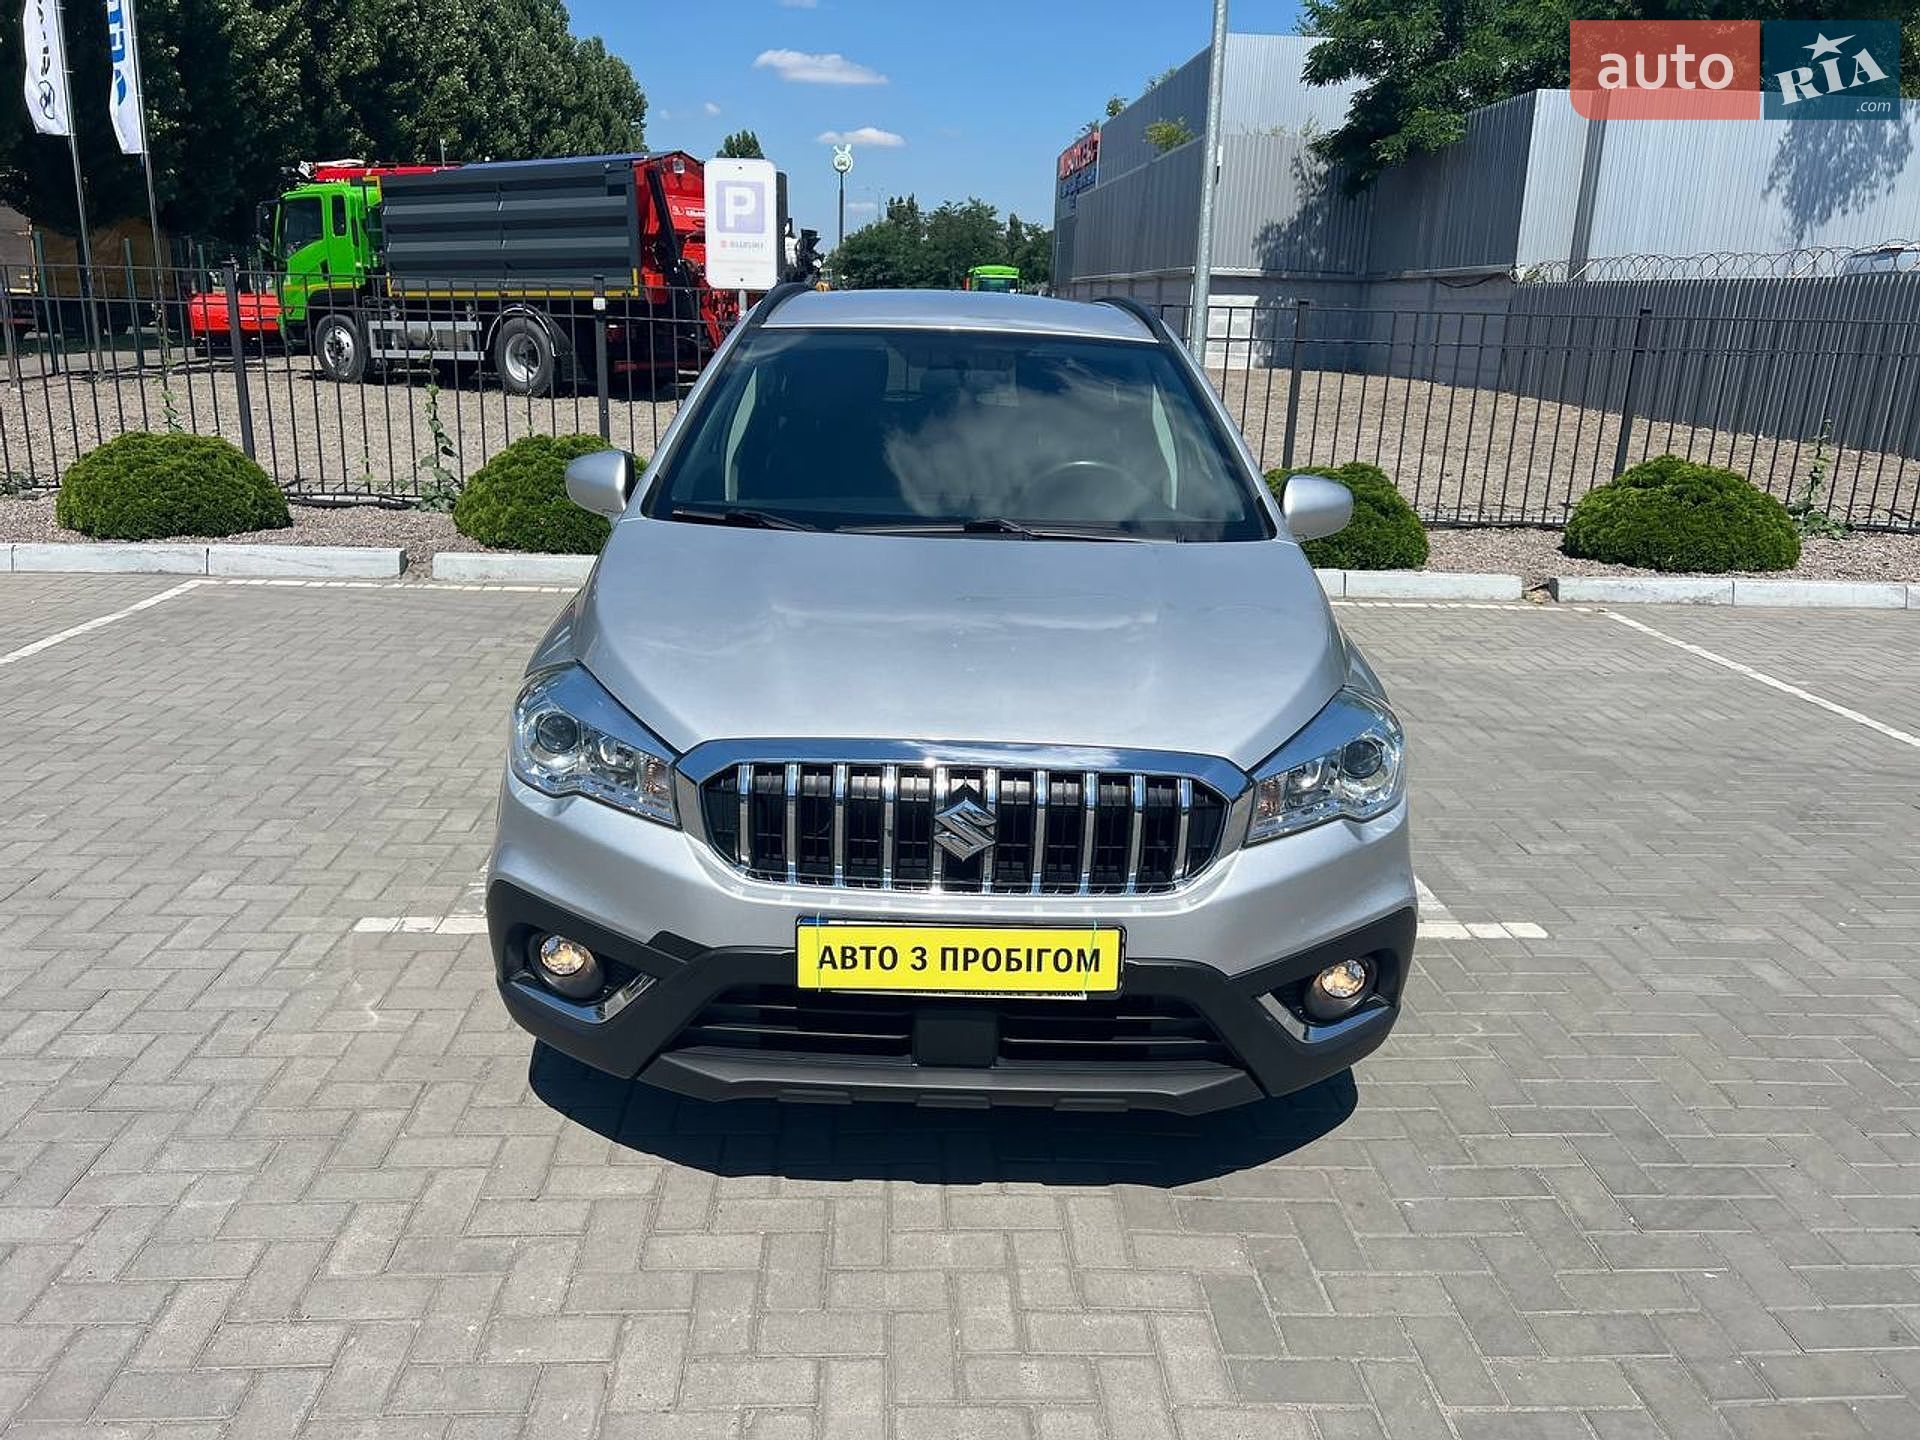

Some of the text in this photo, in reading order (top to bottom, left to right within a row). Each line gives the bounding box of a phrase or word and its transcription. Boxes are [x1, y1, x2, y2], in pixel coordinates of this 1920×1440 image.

[724, 186, 756, 228] P
[819, 945, 898, 971] АВТО
[940, 946, 1100, 973] ПРОБІГОМ
